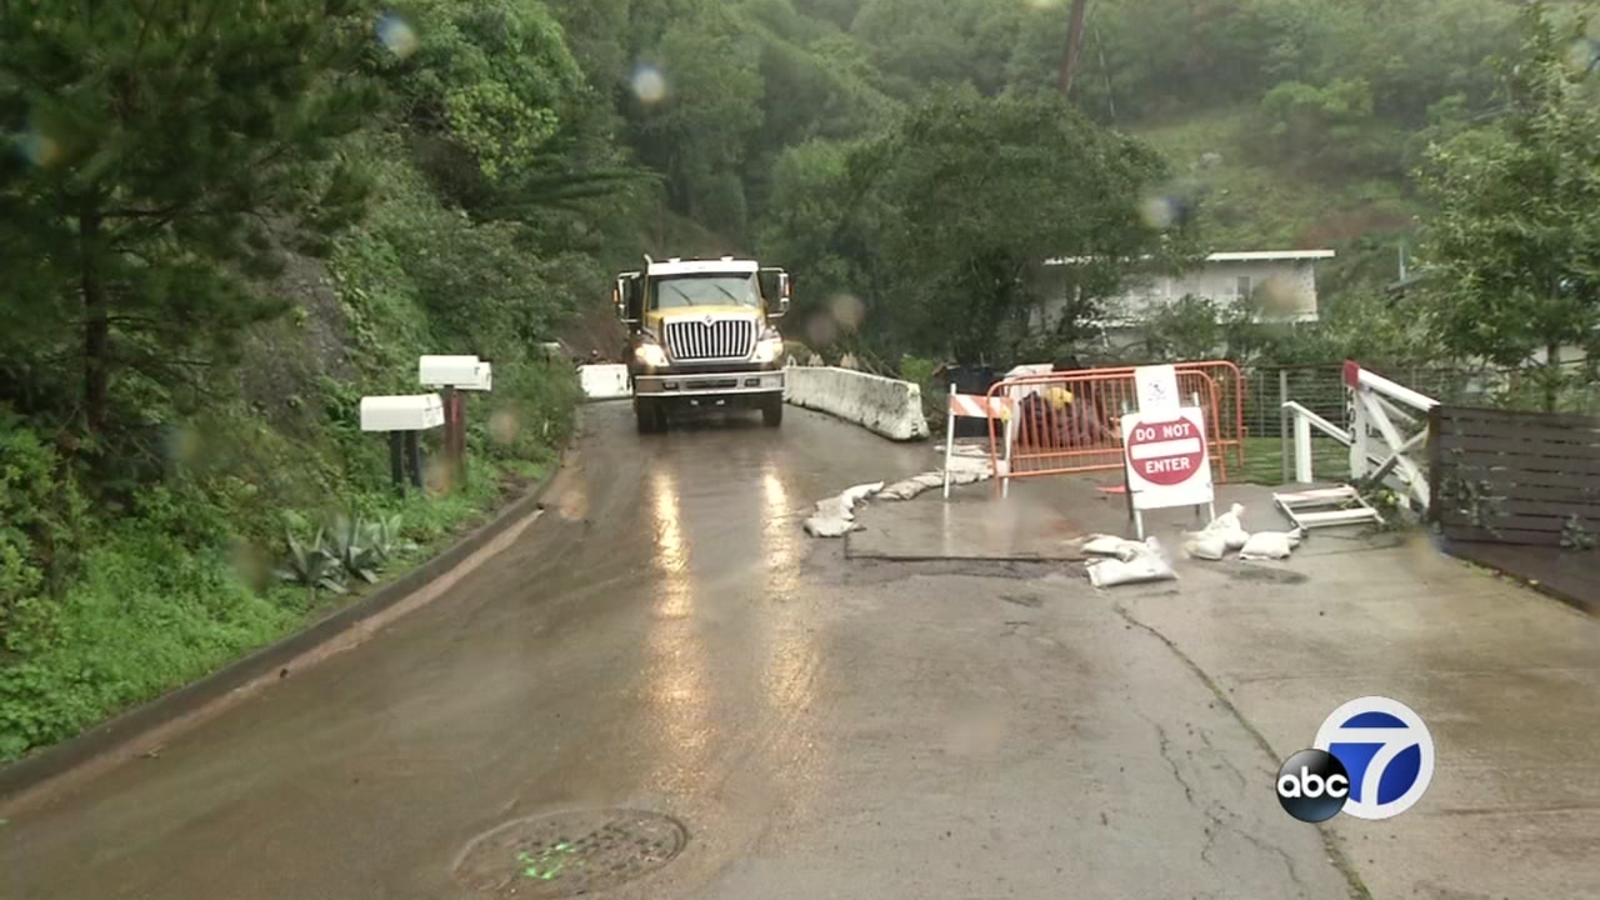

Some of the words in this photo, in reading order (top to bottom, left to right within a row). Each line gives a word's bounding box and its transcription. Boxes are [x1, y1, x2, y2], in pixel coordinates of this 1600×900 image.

[1136, 427, 1156, 441] DO
[1163, 423, 1190, 437] NOT
[1145, 457, 1190, 474] ENTER
